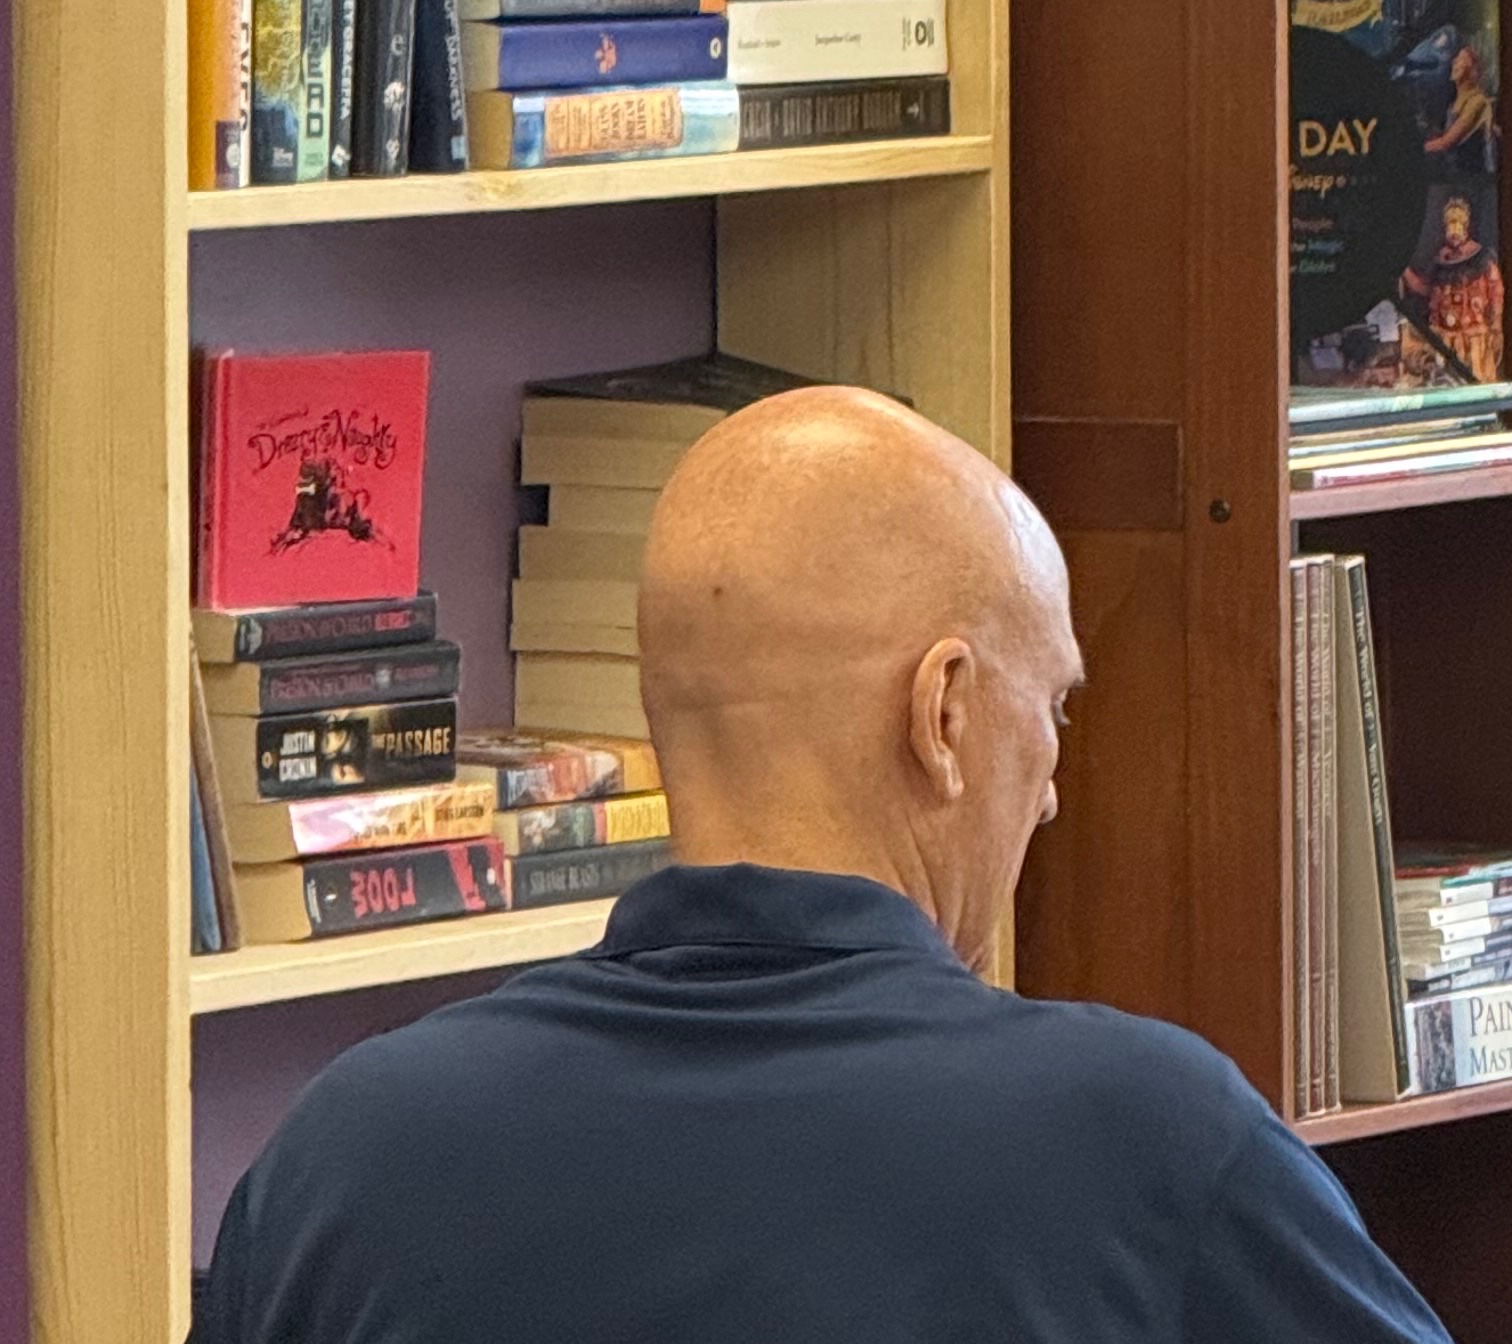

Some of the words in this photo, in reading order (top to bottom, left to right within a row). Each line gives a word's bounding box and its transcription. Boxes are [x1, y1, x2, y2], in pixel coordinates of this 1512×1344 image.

[338, 27, 354, 121] GRACEFFA
[445, 34, 463, 121] DARKNESS
[1299, 118, 1378, 157] DAY
[322, 408, 398, 471] Naughty
[1354, 609, 1367, 644] The
[1358, 645, 1373, 697] World
[1363, 702, 1375, 720] of
[280, 730, 316, 756] JUSTIN
[385, 727, 451, 756] PASSAGE
[279, 756, 318, 783] CRONIN
